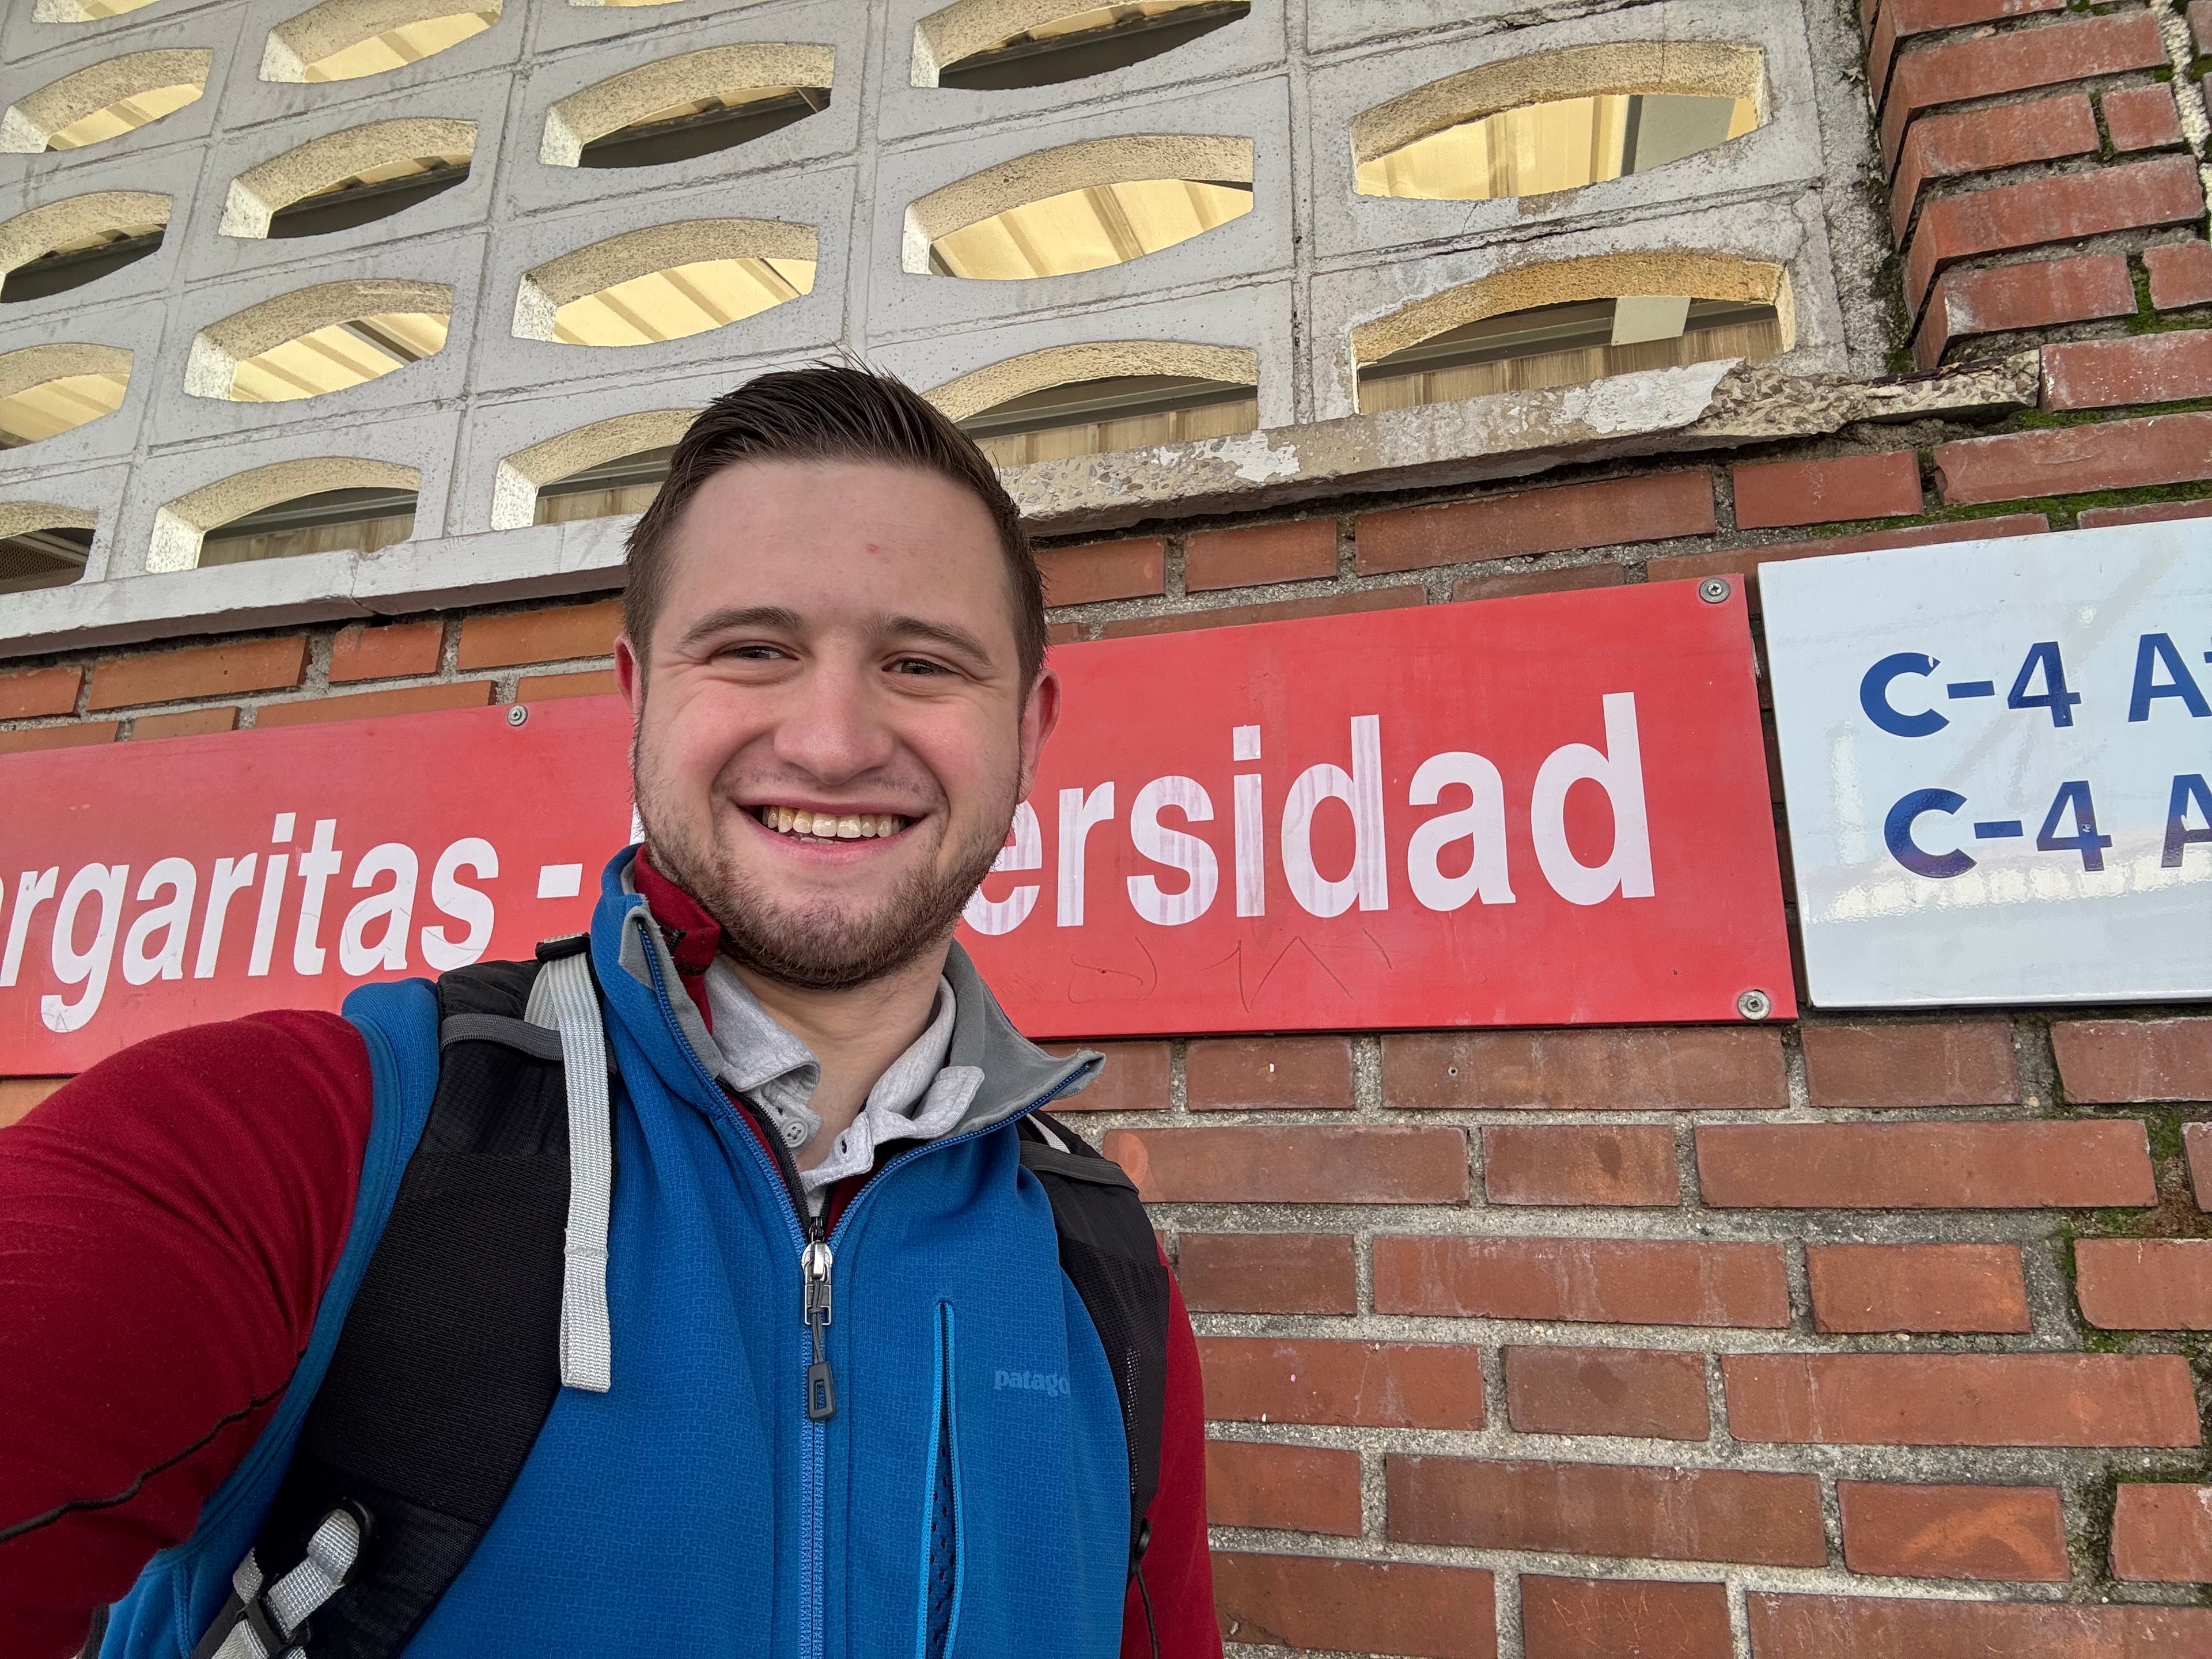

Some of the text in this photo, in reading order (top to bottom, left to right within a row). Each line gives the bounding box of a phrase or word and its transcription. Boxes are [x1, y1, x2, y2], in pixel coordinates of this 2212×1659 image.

[1859, 632, 2212, 738] C-4 A
[0, 812, 499, 1033] rgaritas
[961, 691, 1656, 936] ersidad
[1884, 780, 2113, 880] C-4
